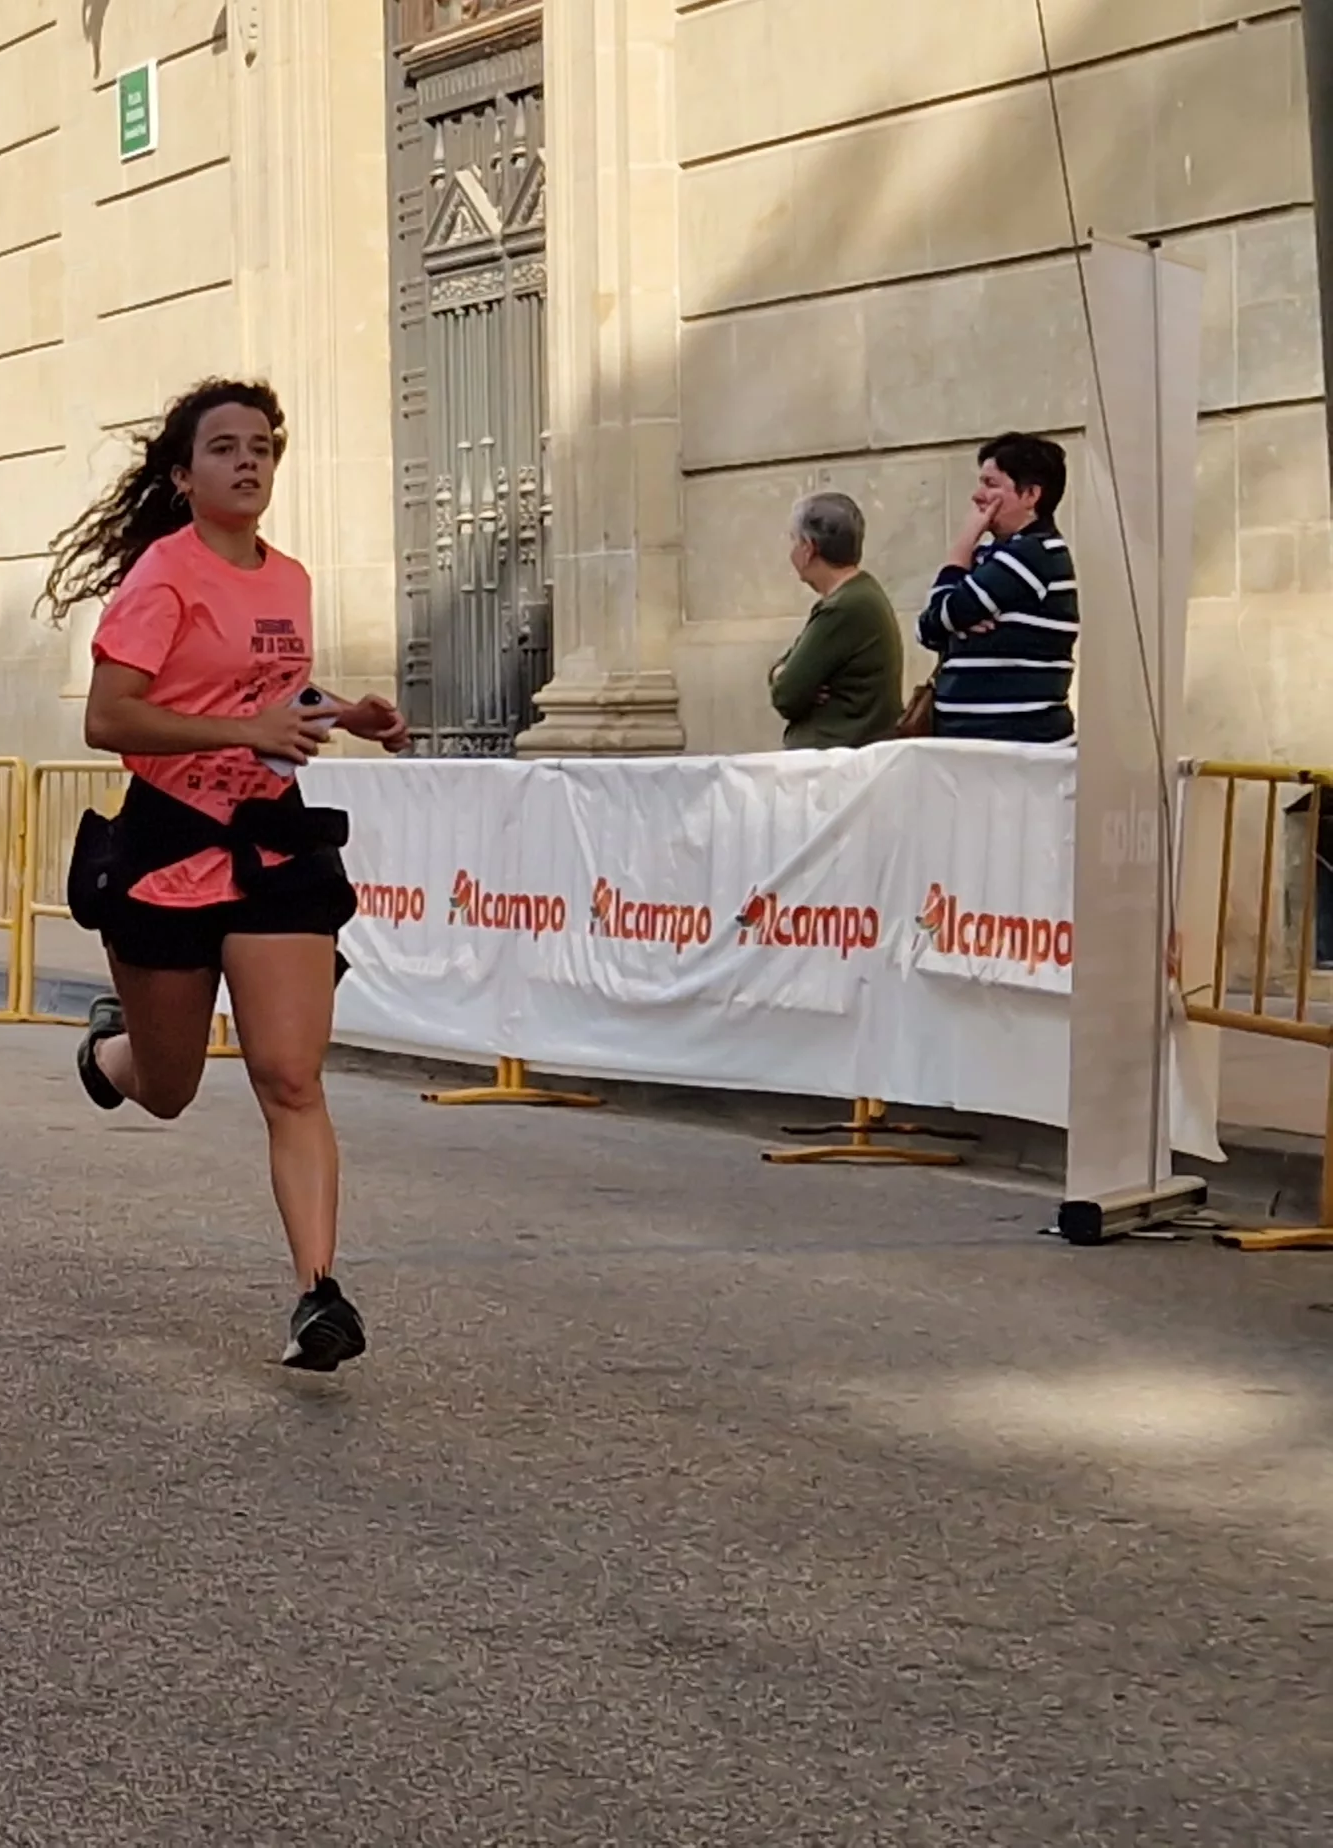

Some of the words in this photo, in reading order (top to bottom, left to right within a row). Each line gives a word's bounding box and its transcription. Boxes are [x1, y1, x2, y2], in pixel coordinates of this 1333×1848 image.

[448, 869, 567, 942] Alcampo
[589, 876, 713, 954] Alcampo
[736, 885, 879, 961] Alcampo
[911, 877, 1074, 975] Alcampo
